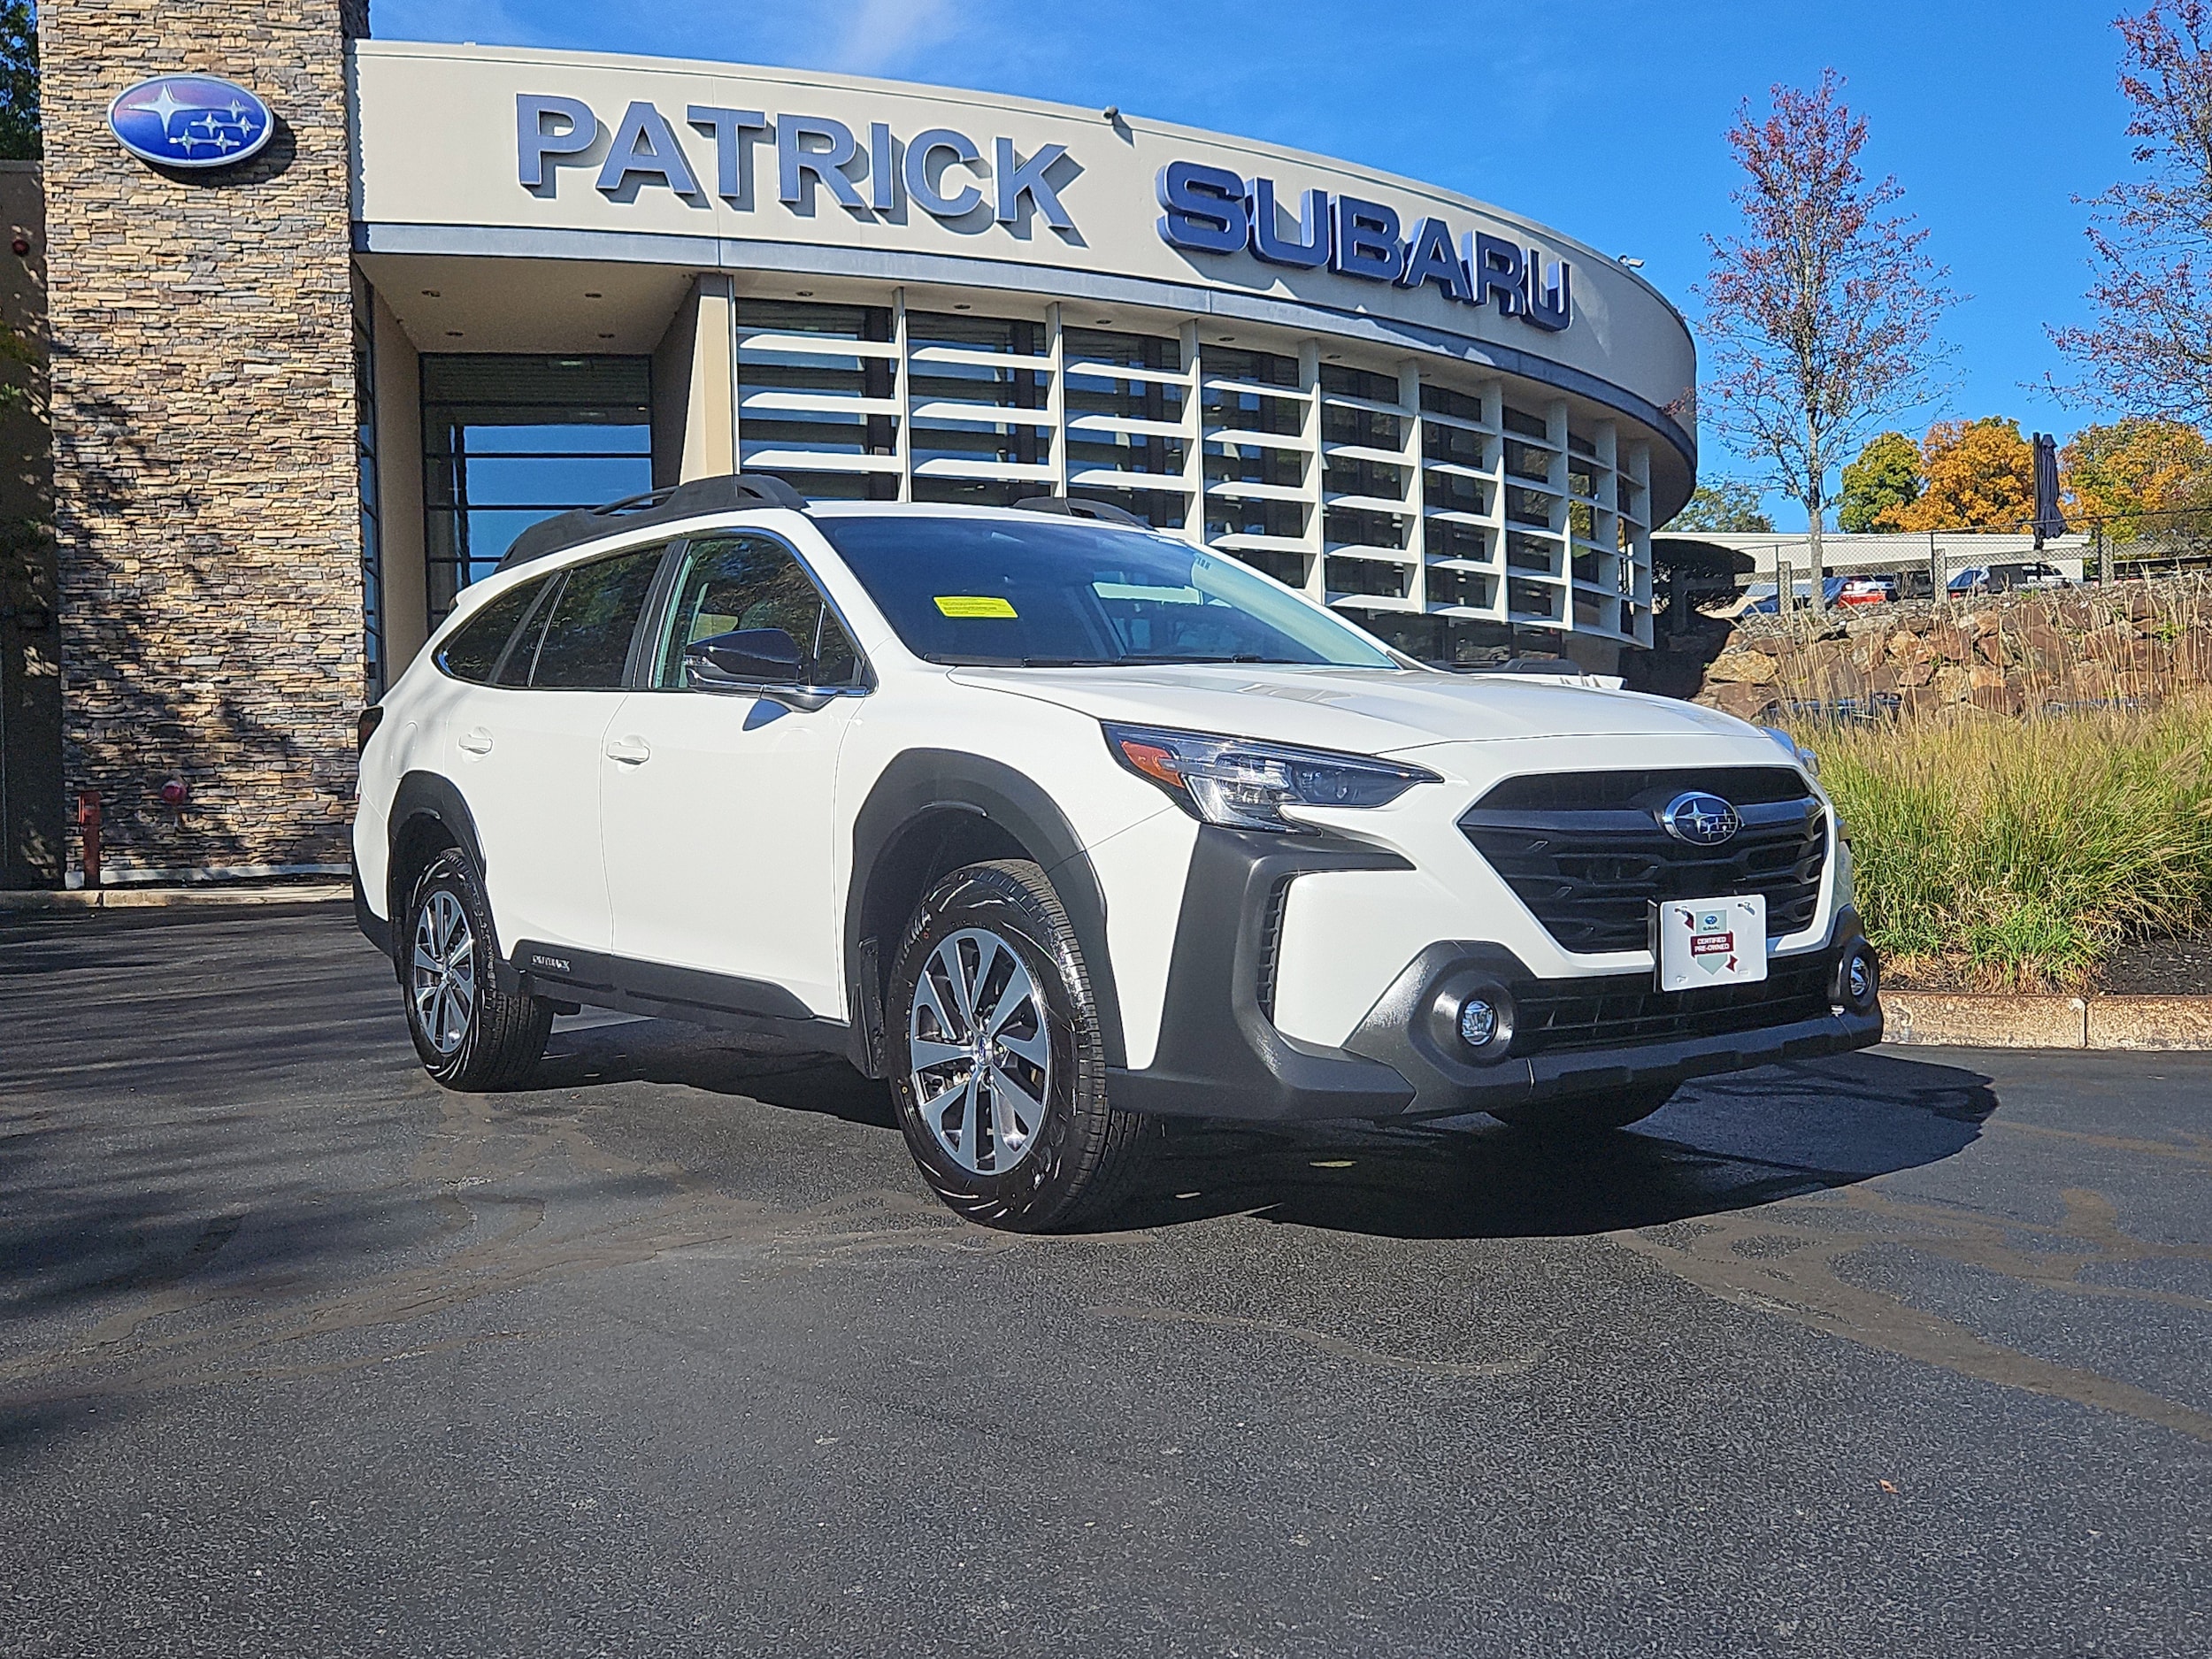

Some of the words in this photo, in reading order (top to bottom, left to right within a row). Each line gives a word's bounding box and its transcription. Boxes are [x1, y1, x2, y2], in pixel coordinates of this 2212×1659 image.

[517, 93, 1072, 234] PATRICK
[1156, 160, 1572, 332] SUBARU
[1696, 936, 1727, 945] CERTIFIED
[1694, 942, 1731, 952] PRE-OWNED
